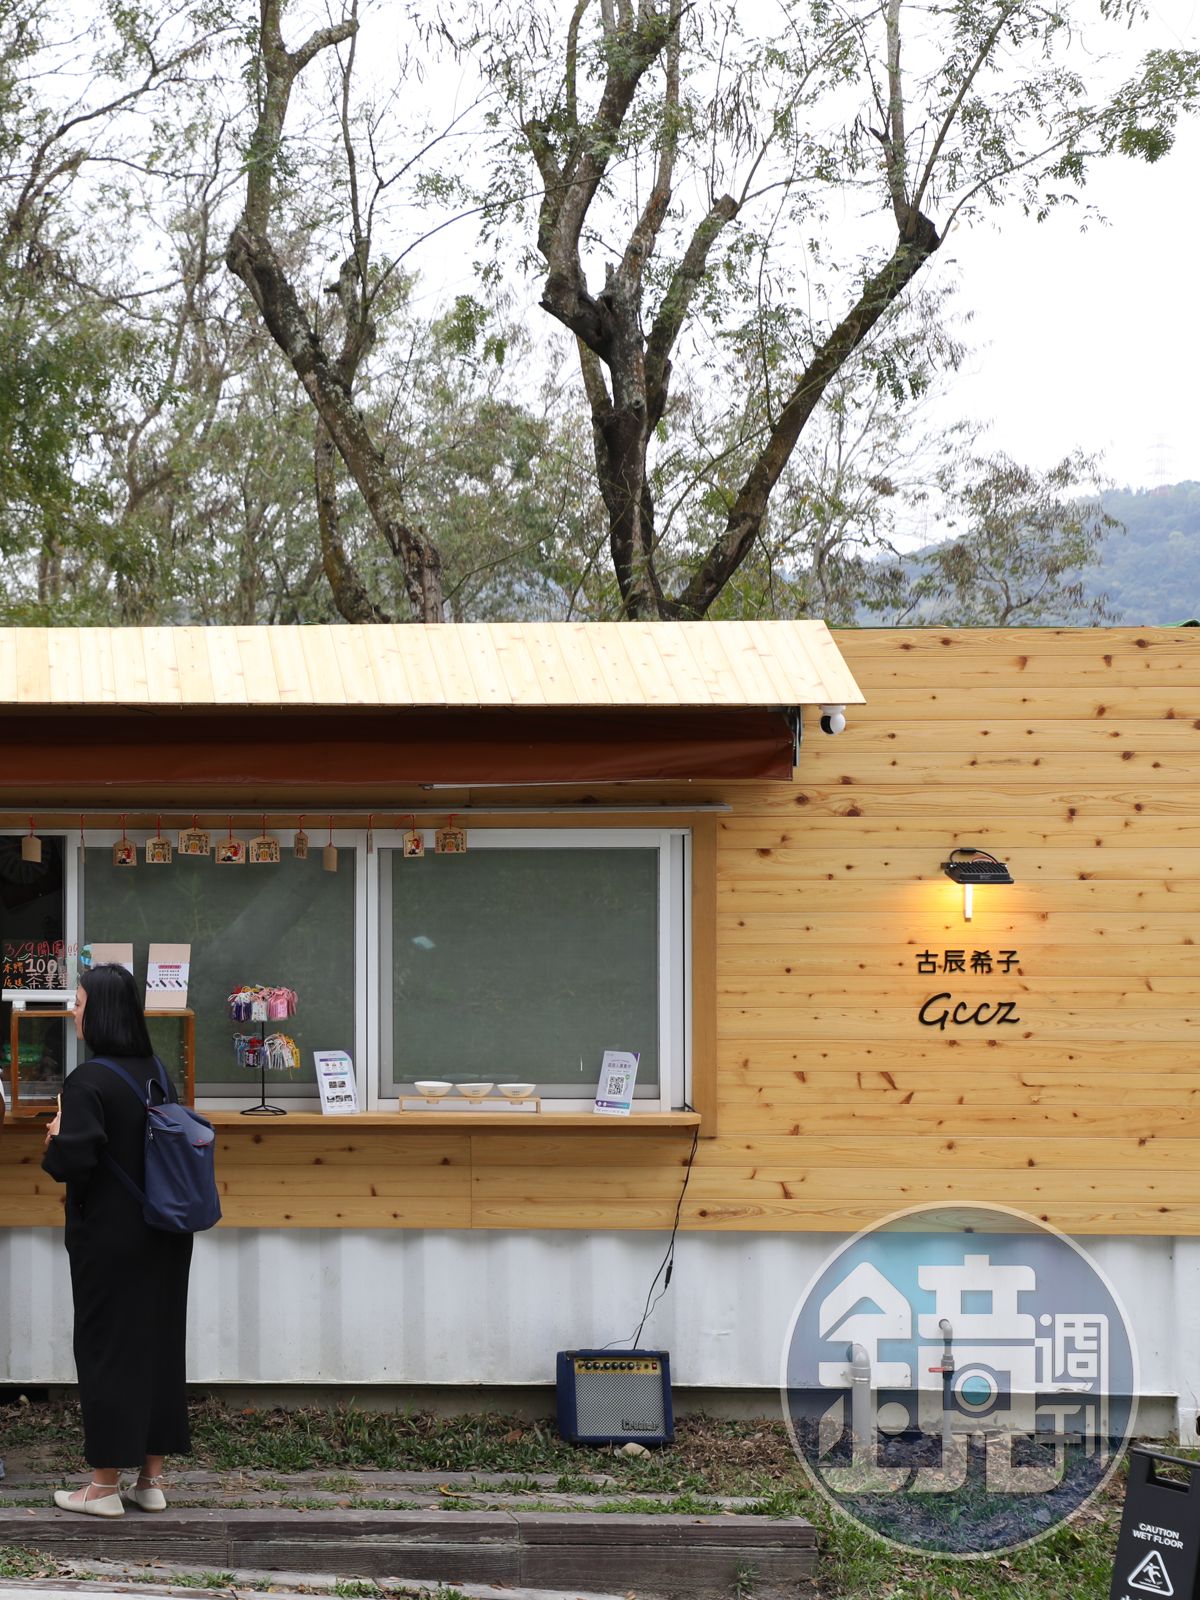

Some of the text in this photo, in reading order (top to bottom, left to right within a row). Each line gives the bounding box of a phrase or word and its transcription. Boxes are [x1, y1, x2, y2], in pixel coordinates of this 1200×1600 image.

[916, 949, 1020, 974] 古辰希子
[1132, 1529, 1184, 1550] WET FLOOR
[1139, 1523, 1180, 1540] CAUTION
